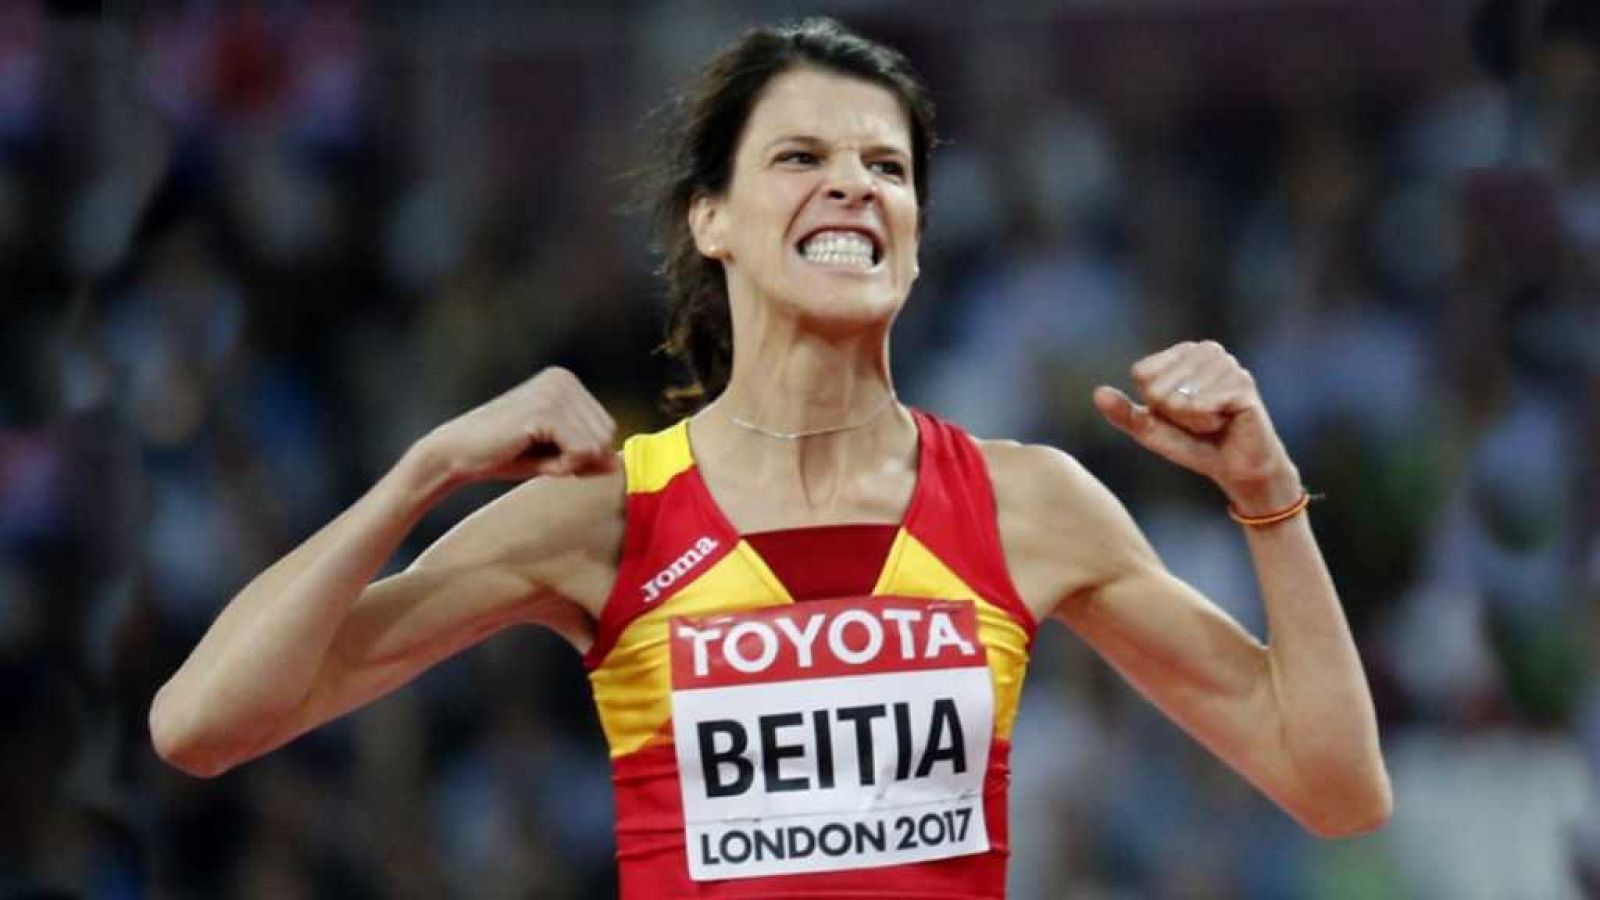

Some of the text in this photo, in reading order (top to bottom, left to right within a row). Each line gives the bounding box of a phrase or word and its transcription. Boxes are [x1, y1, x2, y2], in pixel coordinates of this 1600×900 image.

[678, 608, 976, 676] TOYOTA
[696, 697, 967, 799] BEITIA
[701, 809, 973, 865] LONDON 2017
